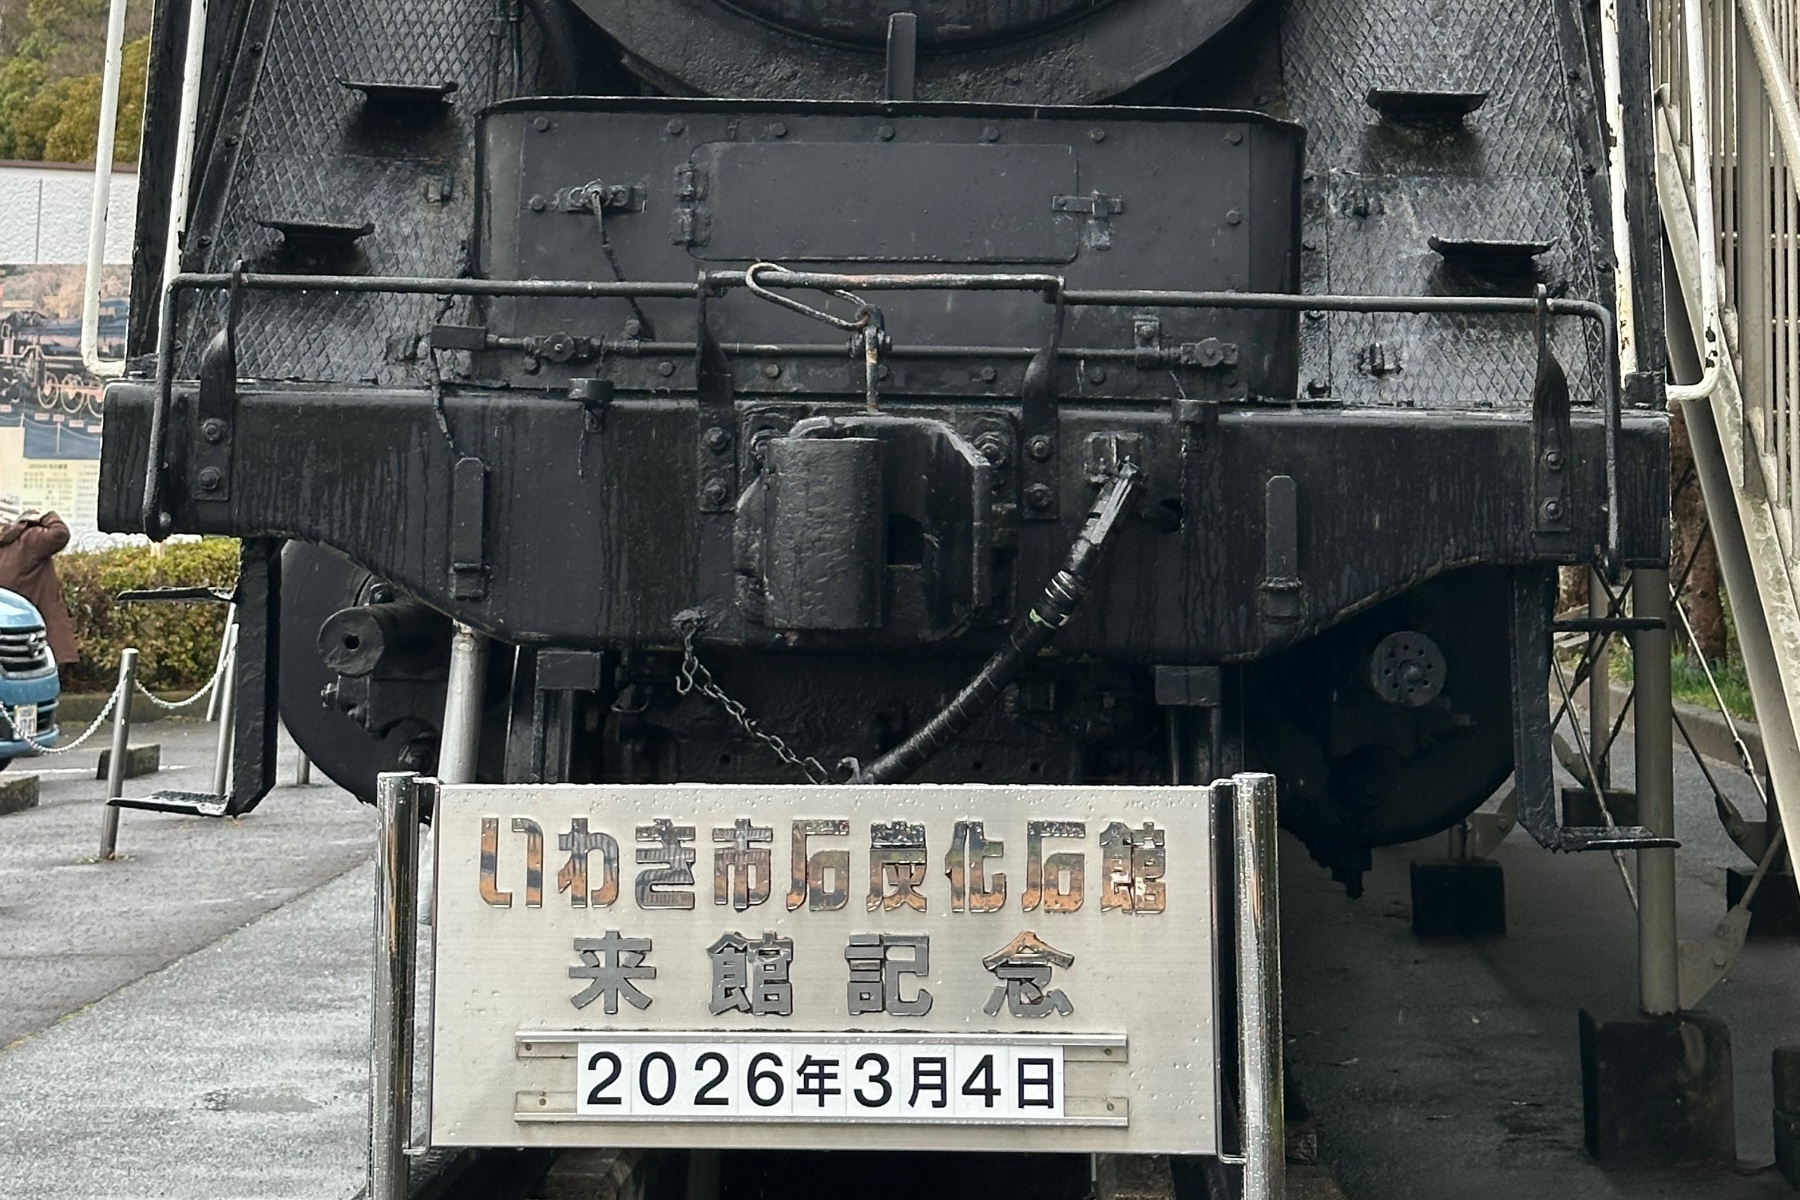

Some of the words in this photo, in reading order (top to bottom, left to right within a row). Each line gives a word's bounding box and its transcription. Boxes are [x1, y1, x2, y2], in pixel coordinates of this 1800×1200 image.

[478, 816, 1167, 916] いわき市石炭化石館
[567, 930, 1076, 1020] 来館記念
[586, 1051, 1055, 1110] 2026年3月4日
